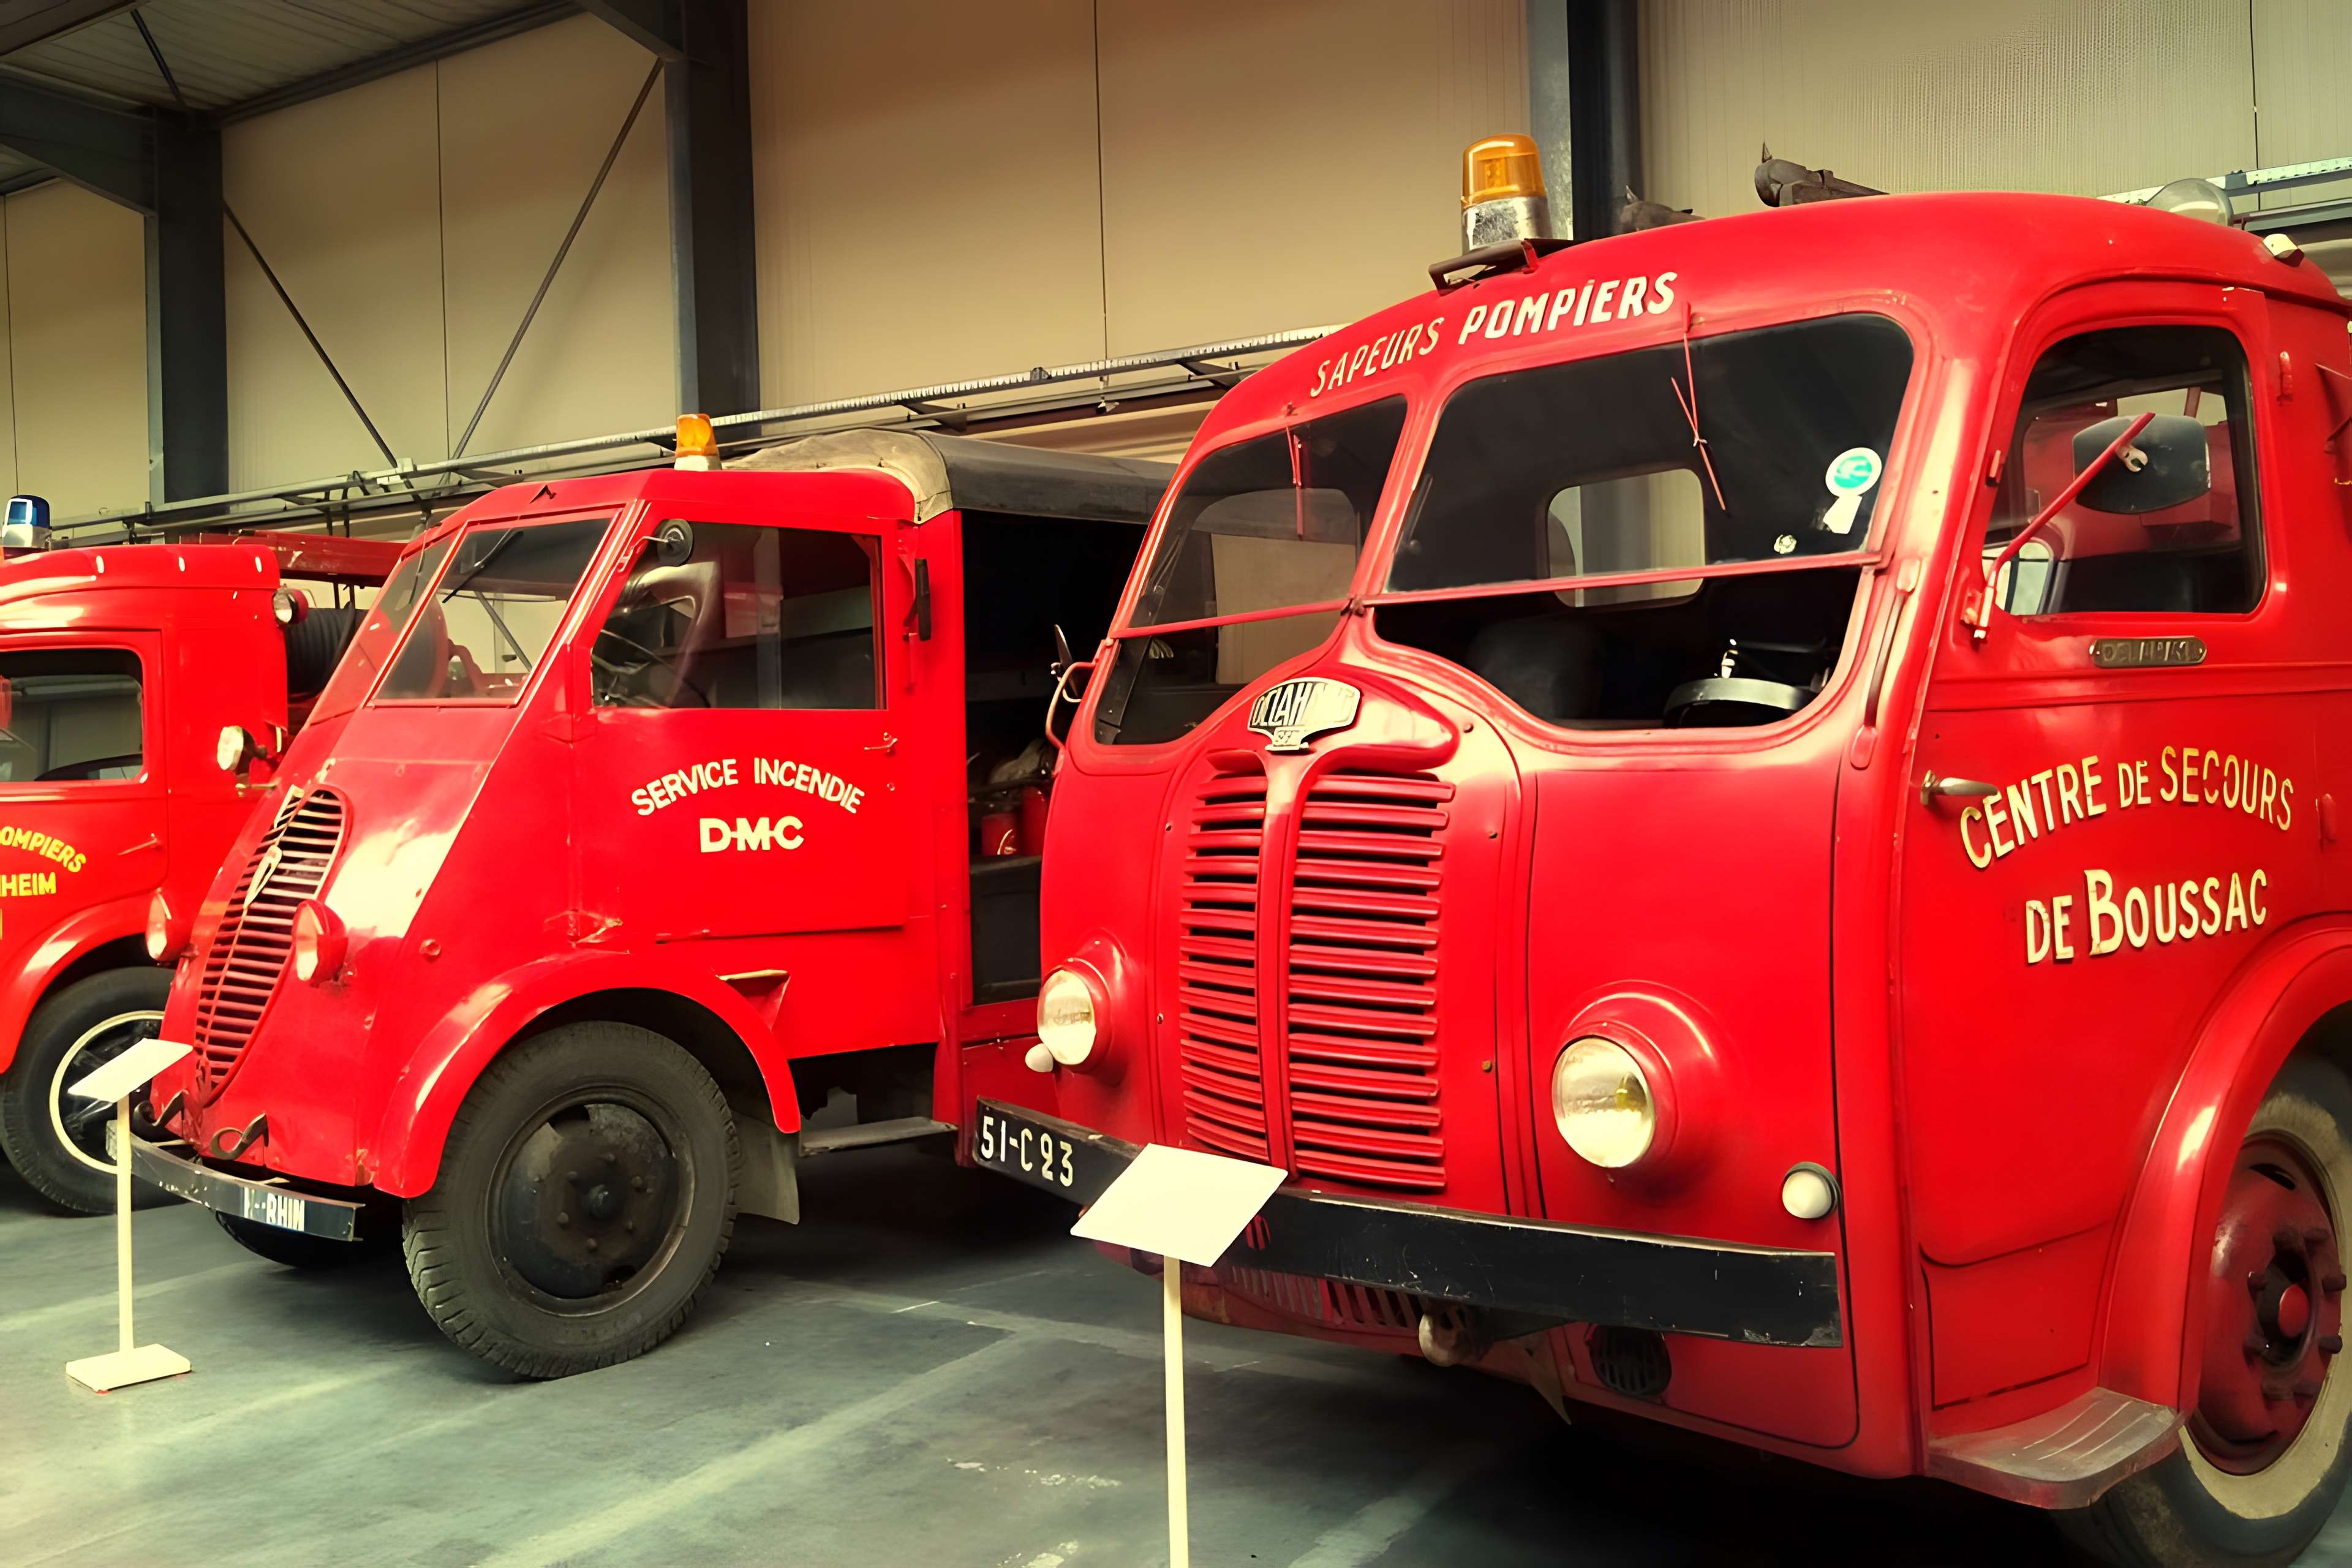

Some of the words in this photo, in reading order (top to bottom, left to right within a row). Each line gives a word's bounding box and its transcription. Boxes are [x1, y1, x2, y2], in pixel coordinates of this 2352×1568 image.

[1310, 317, 1444, 398] SAPEURS
[1458, 271, 1677, 345] POMPIERS
[631, 759, 739, 815] SERVICE
[754, 758, 864, 813] INCENDIE
[1961, 755, 2107, 869] CENTRE
[2118, 761, 2151, 807] DE
[2160, 746, 2293, 830] SECOURS
[0, 826, 86, 872] OMPIERS
[0, 872, 56, 897] HEIM
[2026, 895, 2073, 963] DE
[2084, 869, 2266, 955] BOUSSAC
